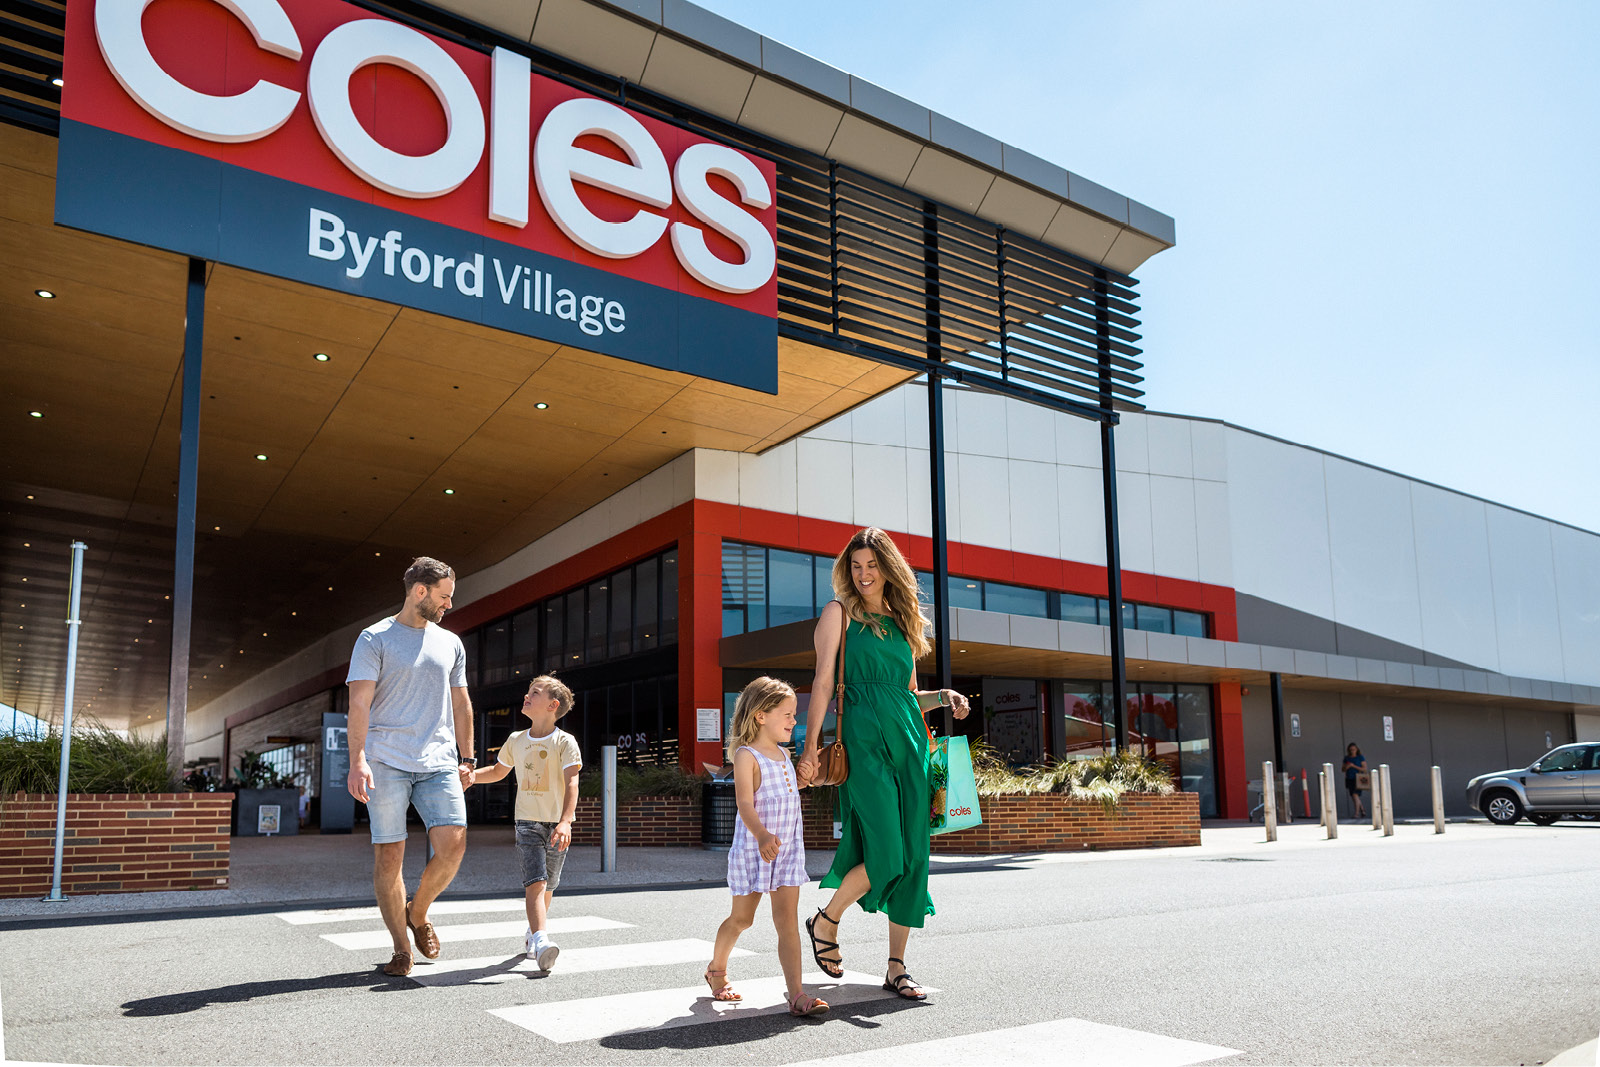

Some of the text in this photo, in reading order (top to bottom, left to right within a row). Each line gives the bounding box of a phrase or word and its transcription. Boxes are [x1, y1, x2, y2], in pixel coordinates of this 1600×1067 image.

[94, 0, 777, 294] coles
[307, 208, 627, 336] Byford Village
[995, 691, 1021, 704] coles
[617, 732, 647, 749] cos
[949, 805, 972, 817] coles
